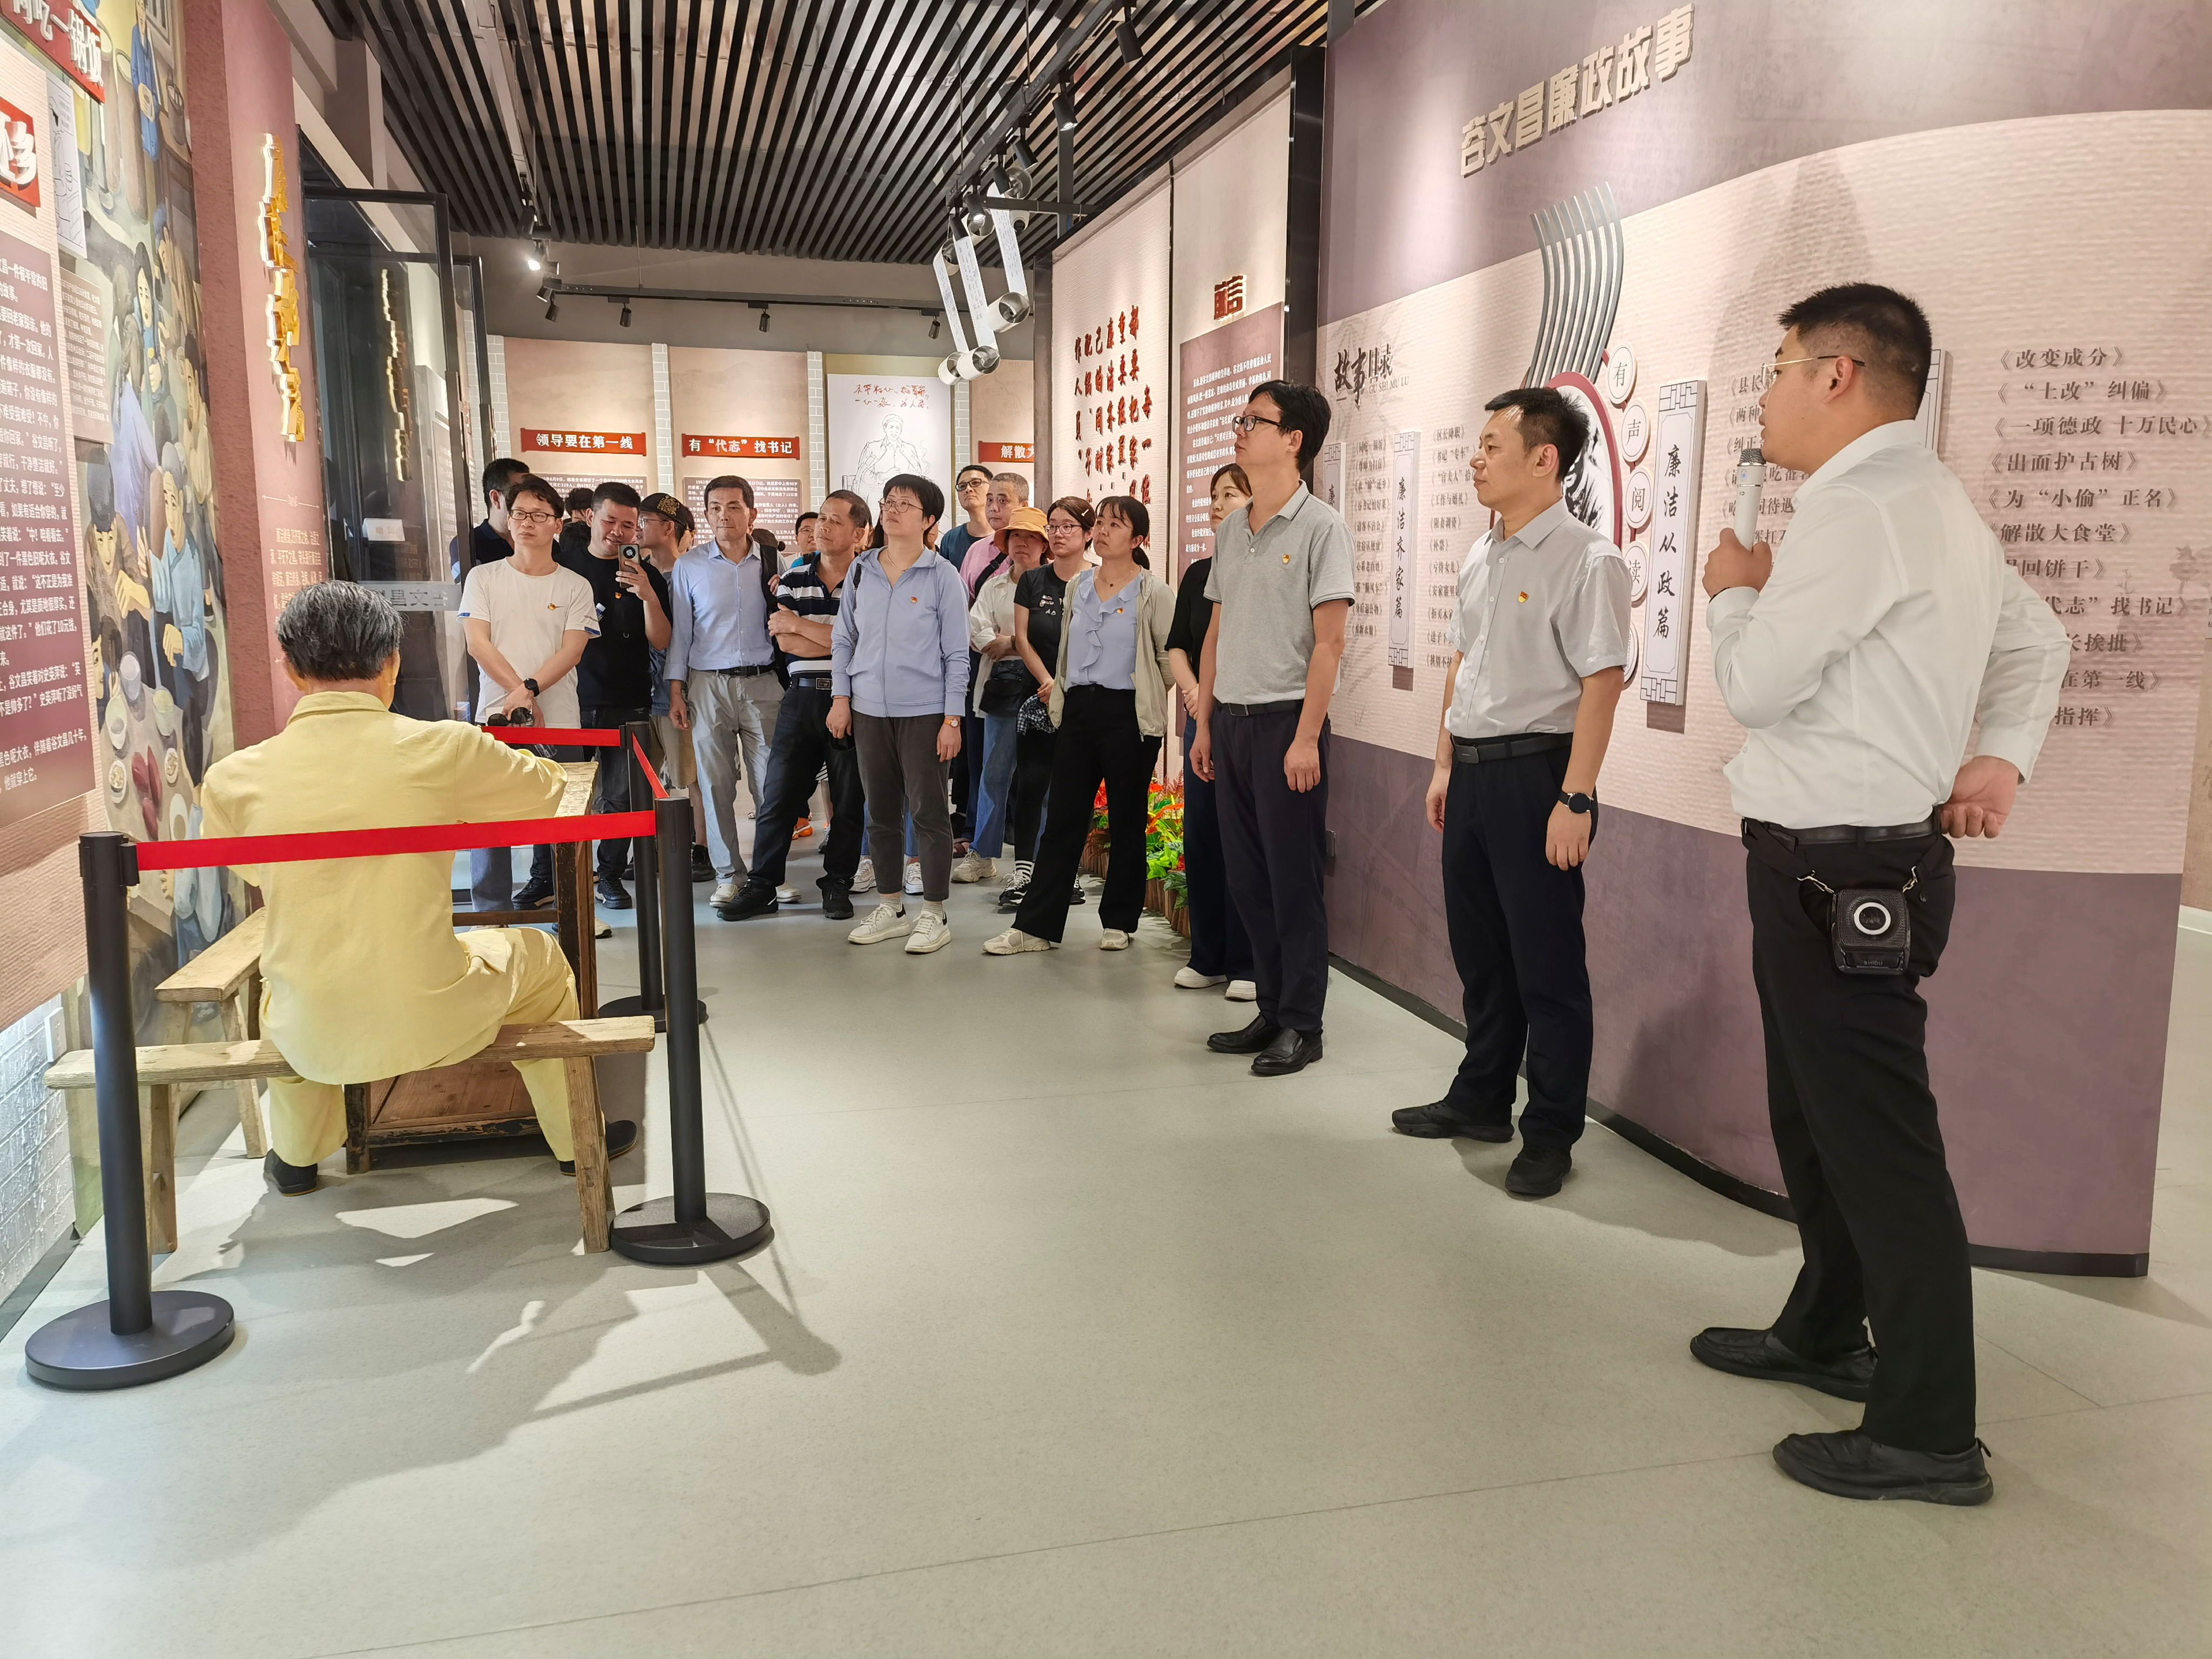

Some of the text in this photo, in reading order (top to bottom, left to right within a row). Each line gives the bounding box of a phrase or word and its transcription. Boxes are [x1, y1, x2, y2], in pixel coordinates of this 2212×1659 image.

[1461, 3, 1695, 177] 谷文昌廉政故事
[2000, 346, 2123, 370] 《改变成分》
[1334, 343, 1393, 406] 故事目录
[1369, 375, 1410, 394] GU SHI MU LU
[536, 433, 633, 449] 领导要在第一线
[689, 439, 792, 454] 有“代志”找书记
[1992, 450, 2136, 474] 《出面护古树》
[1653, 444, 1682, 639] 廉洁从政篇
[2054, 706, 2113, 727] 指挥》
